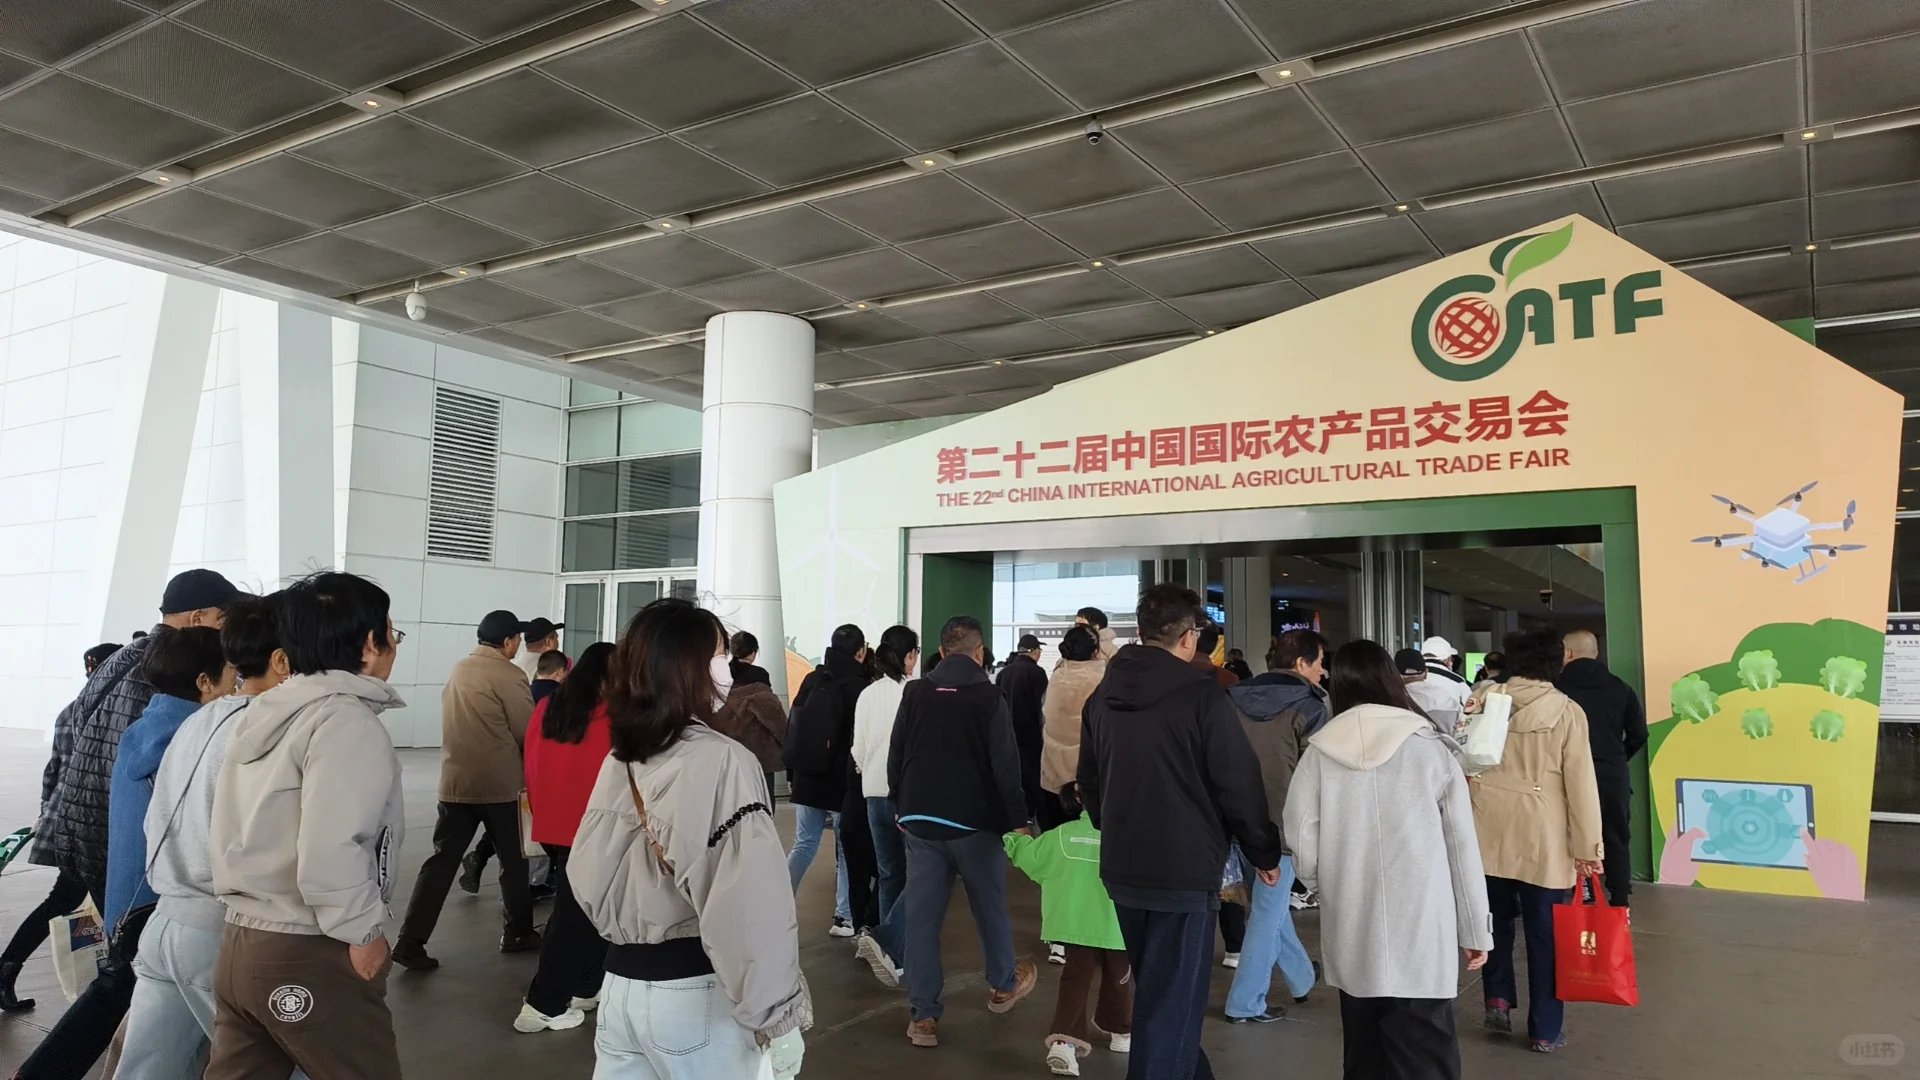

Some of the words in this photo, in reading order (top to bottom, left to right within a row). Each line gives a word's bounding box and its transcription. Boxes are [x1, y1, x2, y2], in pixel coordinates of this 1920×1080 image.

[1411, 269, 1664, 382] CATF
[936, 491, 969, 508] THE
[973, 489, 1004, 506] 22nd
[1008, 485, 1064, 503] CHINA
[1068, 473, 1227, 499] INTERNATIONAL
[1232, 460, 1410, 489] AGRICULTURAL
[1416, 453, 1501, 476] TRADE
[1510, 448, 1571, 470] FAIR
[937, 390, 1570, 484] 第二十二届中国国际农产品交易会
